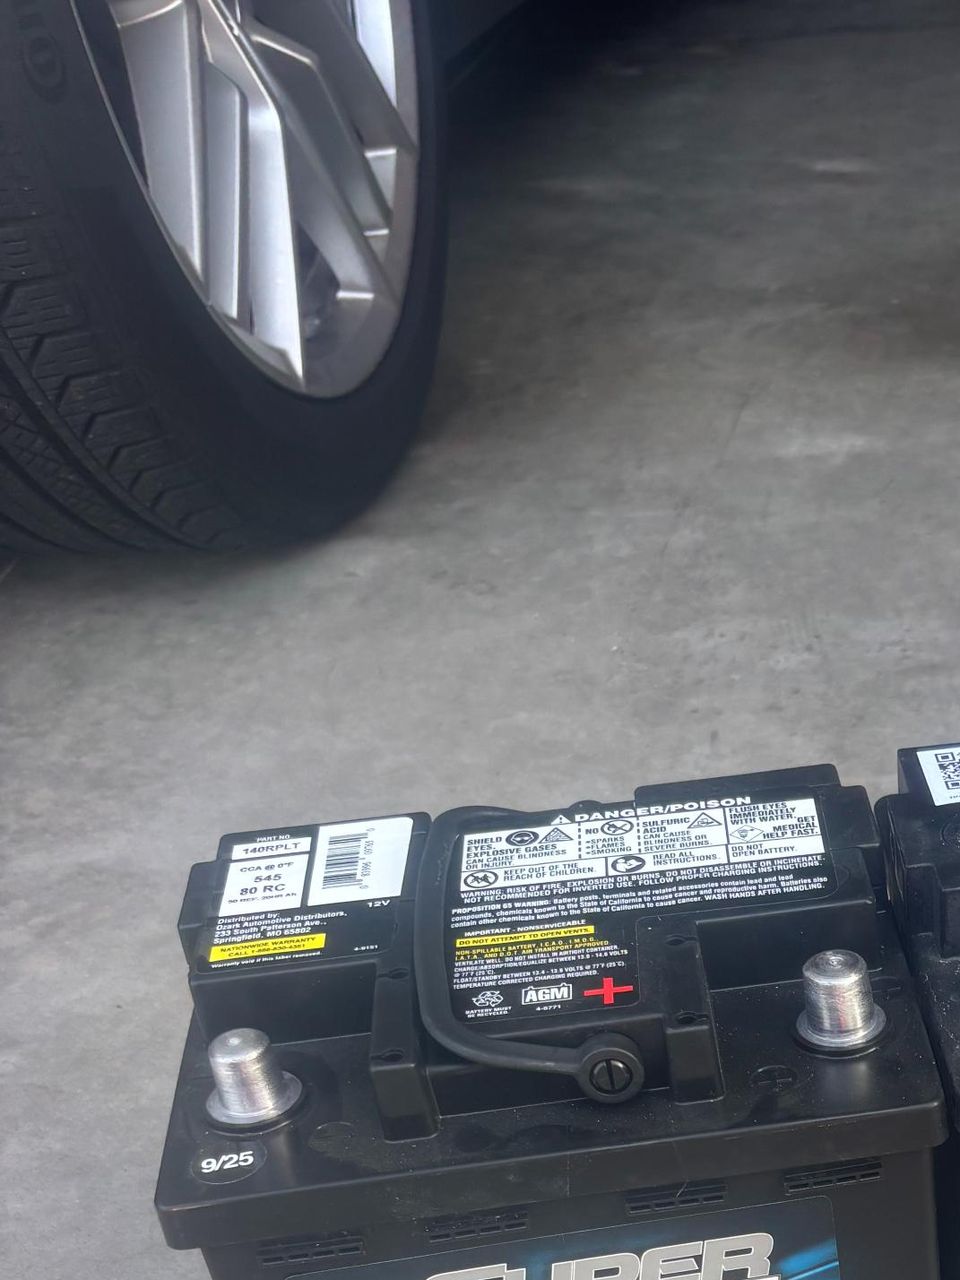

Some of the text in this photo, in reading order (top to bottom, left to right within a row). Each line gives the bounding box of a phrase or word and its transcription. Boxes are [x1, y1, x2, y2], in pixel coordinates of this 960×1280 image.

[575, 797, 751, 822] DANGER/POISON
[729, 801, 787, 813] FLUSH EYES
[730, 807, 796, 819] IMMEDIATELY
[642, 817, 690, 828] SULFURIC
[730, 813, 797, 825] WITH WATER.
[797, 815, 815, 823] GET
[643, 826, 667, 834] ACID
[772, 822, 817, 832] MEDICAL
[663, 830, 691, 838] CAUSE
[763, 831, 788, 840] HELP
[467, 836, 502, 846] SHIELD
[643, 836, 692, 846] BLINDNESS
[242, 842, 301, 855] 140RPLT
[466, 844, 557, 859] EXPLOSIVE GASES
[467, 844, 496, 852] EYES.
[644, 844, 677, 852] SEVERE
[466, 849, 567, 865] CAN CAUSE BLINDNESS
[652, 852, 676, 860] READ
[732, 850, 756, 858] OPEN
[465, 863, 478, 871] OR
[504, 868, 525, 876] KEEP
[528, 866, 545, 874] OUT
[562, 862, 578, 870] THE
[254, 873, 283, 883] 545
[503, 873, 536, 881] REACH
[240, 883, 286, 896] 80 RC
[368, 899, 390, 908] 12V
[216, 923, 241, 931] Ozark
[242, 917, 292, 927] Automotive
[217, 912, 281, 925] Distributed by:
[233, 927, 259, 936] South
[260, 922, 302, 932] Patterson
[266, 930, 282, 938] MO
[284, 926, 312, 936] 65802
[490, 934, 526, 943] ATTEMPT
[529, 932, 539, 940] TO
[540, 930, 560, 938] OPEN
[525, 986, 569, 1003] AGM
[201, 1151, 254, 1173] 9/25
